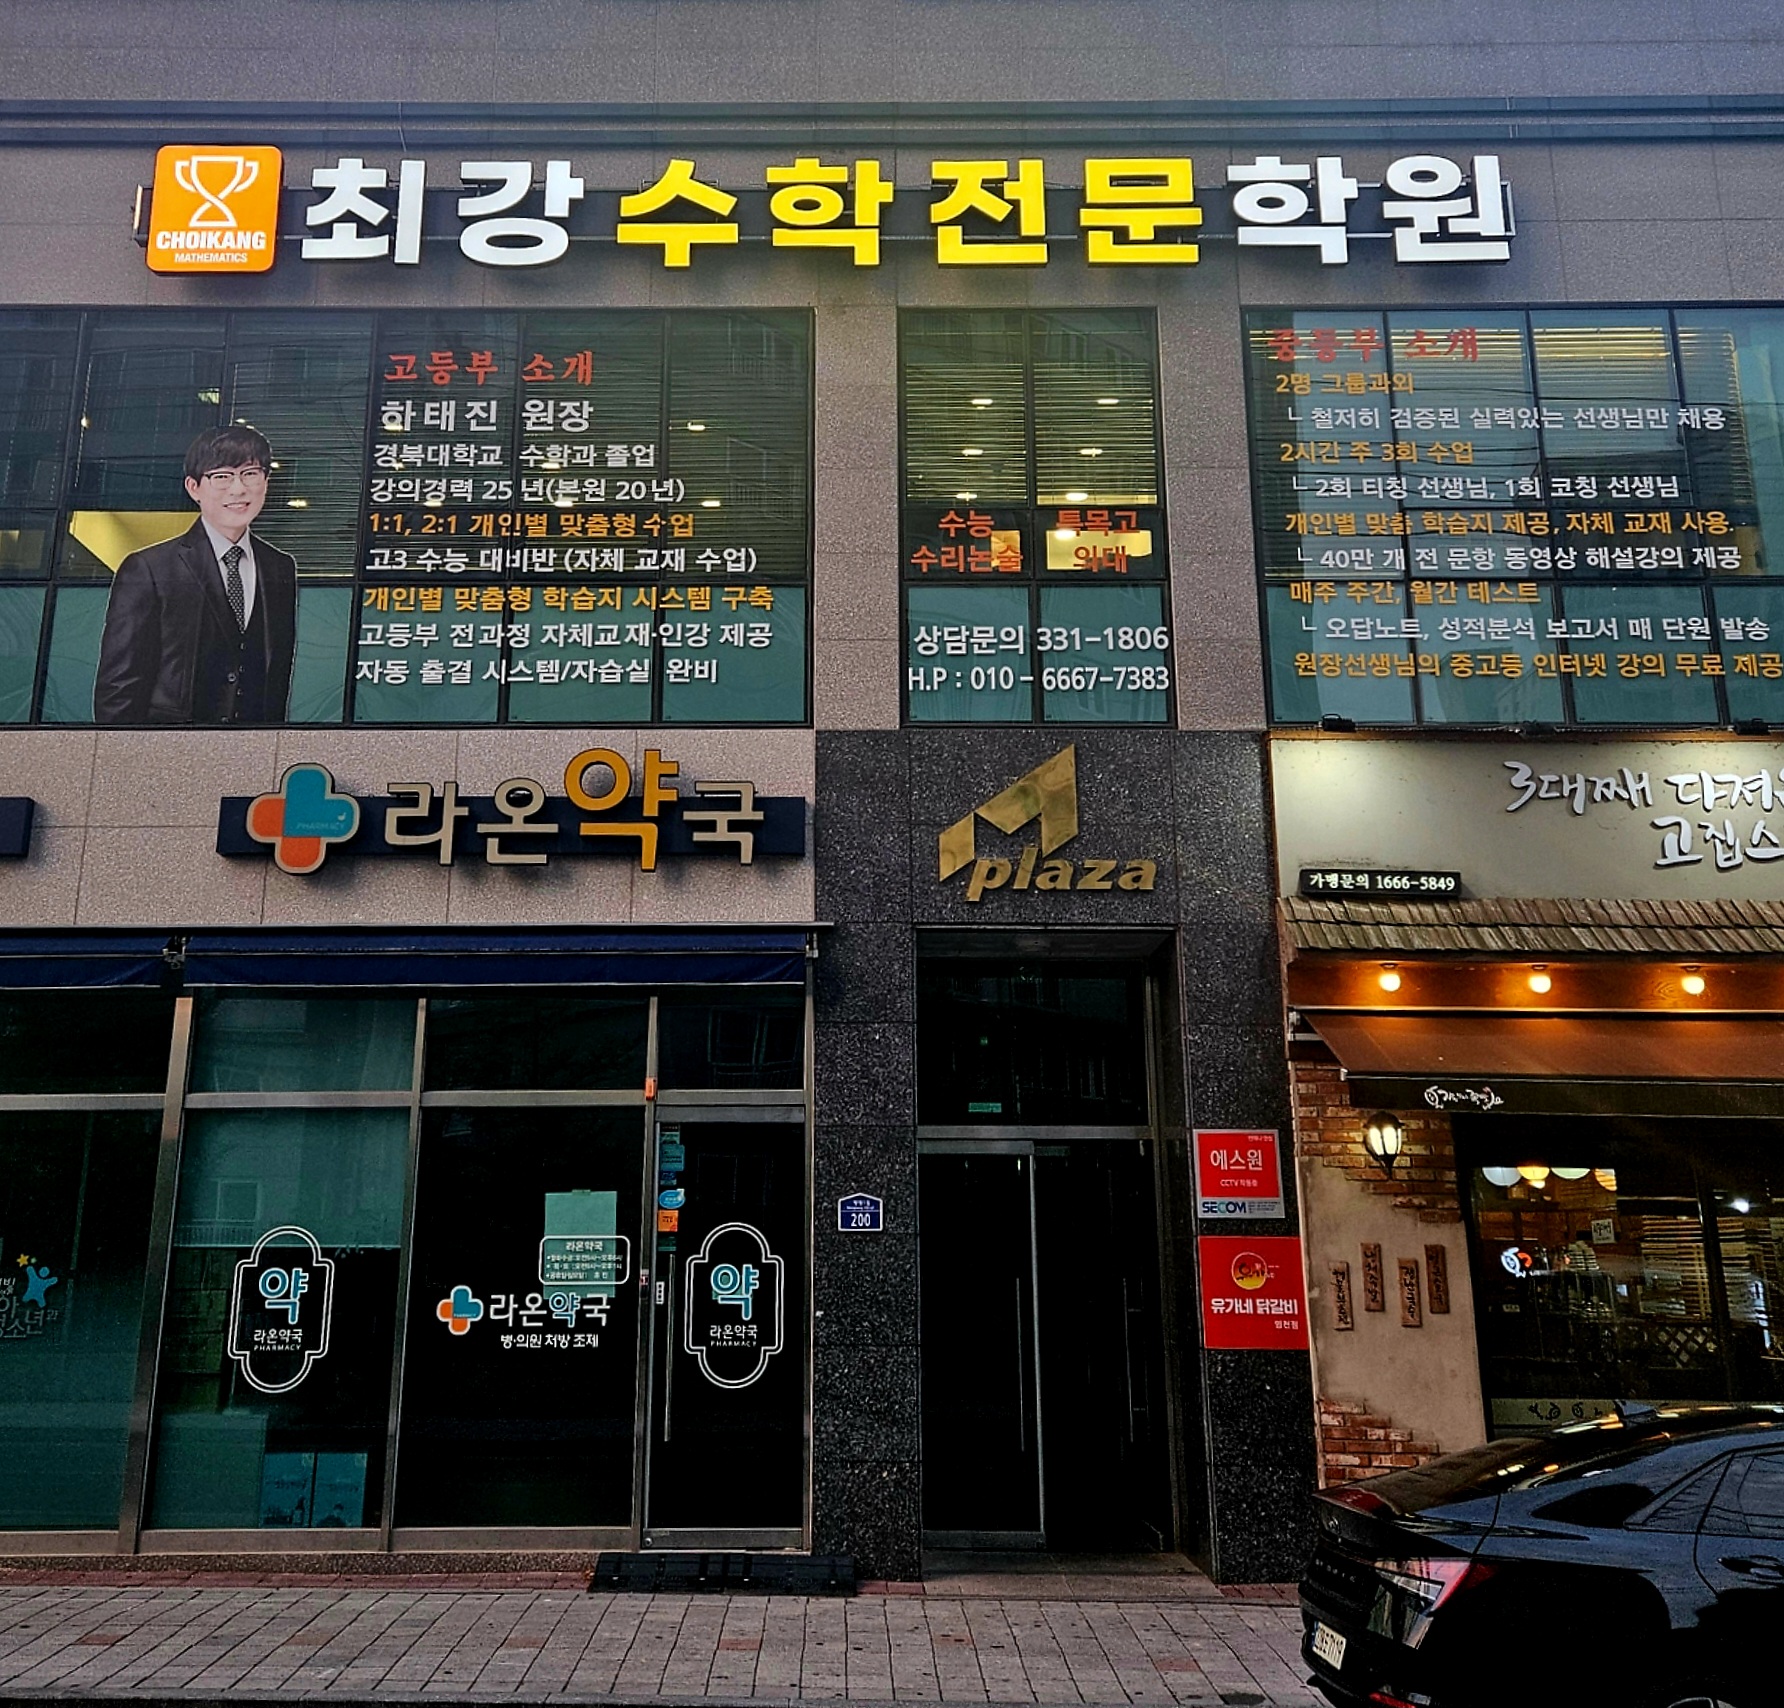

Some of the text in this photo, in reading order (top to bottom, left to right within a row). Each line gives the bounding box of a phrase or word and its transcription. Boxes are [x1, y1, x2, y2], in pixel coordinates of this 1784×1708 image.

[155, 230, 267, 251] CHOIKANG
[174, 252, 248, 264] MATHEMATICS
[1268, 327, 1478, 363] 중등부 소개
[384, 350, 593, 386] 고등부 소개
[1276, 372, 1415, 395] 2명 그룹과외
[381, 399, 593, 433] 하태진 원장
[1311, 407, 1727, 431] 철저히 검증된 실력있는 선생님만 채용
[373, 444, 656, 468] 경북대학교 수학과 졸업
[1280, 441, 1474, 464] 2시간 주 3회 수업
[370, 479, 475, 502] 강의경력
[1316, 476, 1680, 501] 2회 티칭 선생님, 1회 코칭 선생님
[369, 512, 695, 538] 1:1, 2:1 개인별 맞춤형 수업
[938, 510, 1140, 538] 수능 특목고
[1285, 511, 1735, 536] 개인별 맞춤 학습지 제공, 자체 교재 사용.
[366, 547, 757, 573] 고3 수능 대비반 (자체 교재 수업)
[911, 545, 1128, 574] 수리논술 의대
[1320, 546, 1741, 571] 40만 개 전 문항 동영상 해설강의 제공
[364, 587, 774, 612] 개인별 맞춤형 학습지 시스템 구축
[1290, 581, 1542, 605] 매주 주간, 월간 테스트
[358, 623, 439, 648] 고등부
[449, 623, 531, 648] 전과정
[719, 622, 774, 648] 제공
[914, 625, 1169, 656] 상담문의 331-1806
[1325, 617, 1770, 641] 오답노트, 성적분석 보고서 매 단원 발송
[356, 658, 718, 685] 자동 출결 시스템/자습실 완비
[1294, 653, 1784, 678] 원장선생님의 중고등 인터넷 강의 무료 제공
[1503, 761, 1653, 815] 3대째
[384, 747, 765, 872] 라온약국
[965, 845, 1158, 902] plaza
[1309, 873, 1456, 891] 가맹문의 1666-5849
[1210, 1149, 1263, 1171] 에스원
[1220, 1179, 1239, 1187] CCTV
[850, 1213, 871, 1227] 200
[1202, 1201, 1247, 1214] SECOM
[566, 1241, 603, 1252] 라온약국
[259, 1267, 309, 1325] 약
[711, 1263, 759, 1320] 약
[490, 1291, 611, 1328] 라온약국
[1211, 1298, 1298, 1315] 유가네 닭갈비
[253, 1328, 303, 1344] 라온약국
[545, 1333, 571, 1349] 처방
[573, 1333, 599, 1348] 조제
[710, 1324, 757, 1339] 라온약국
